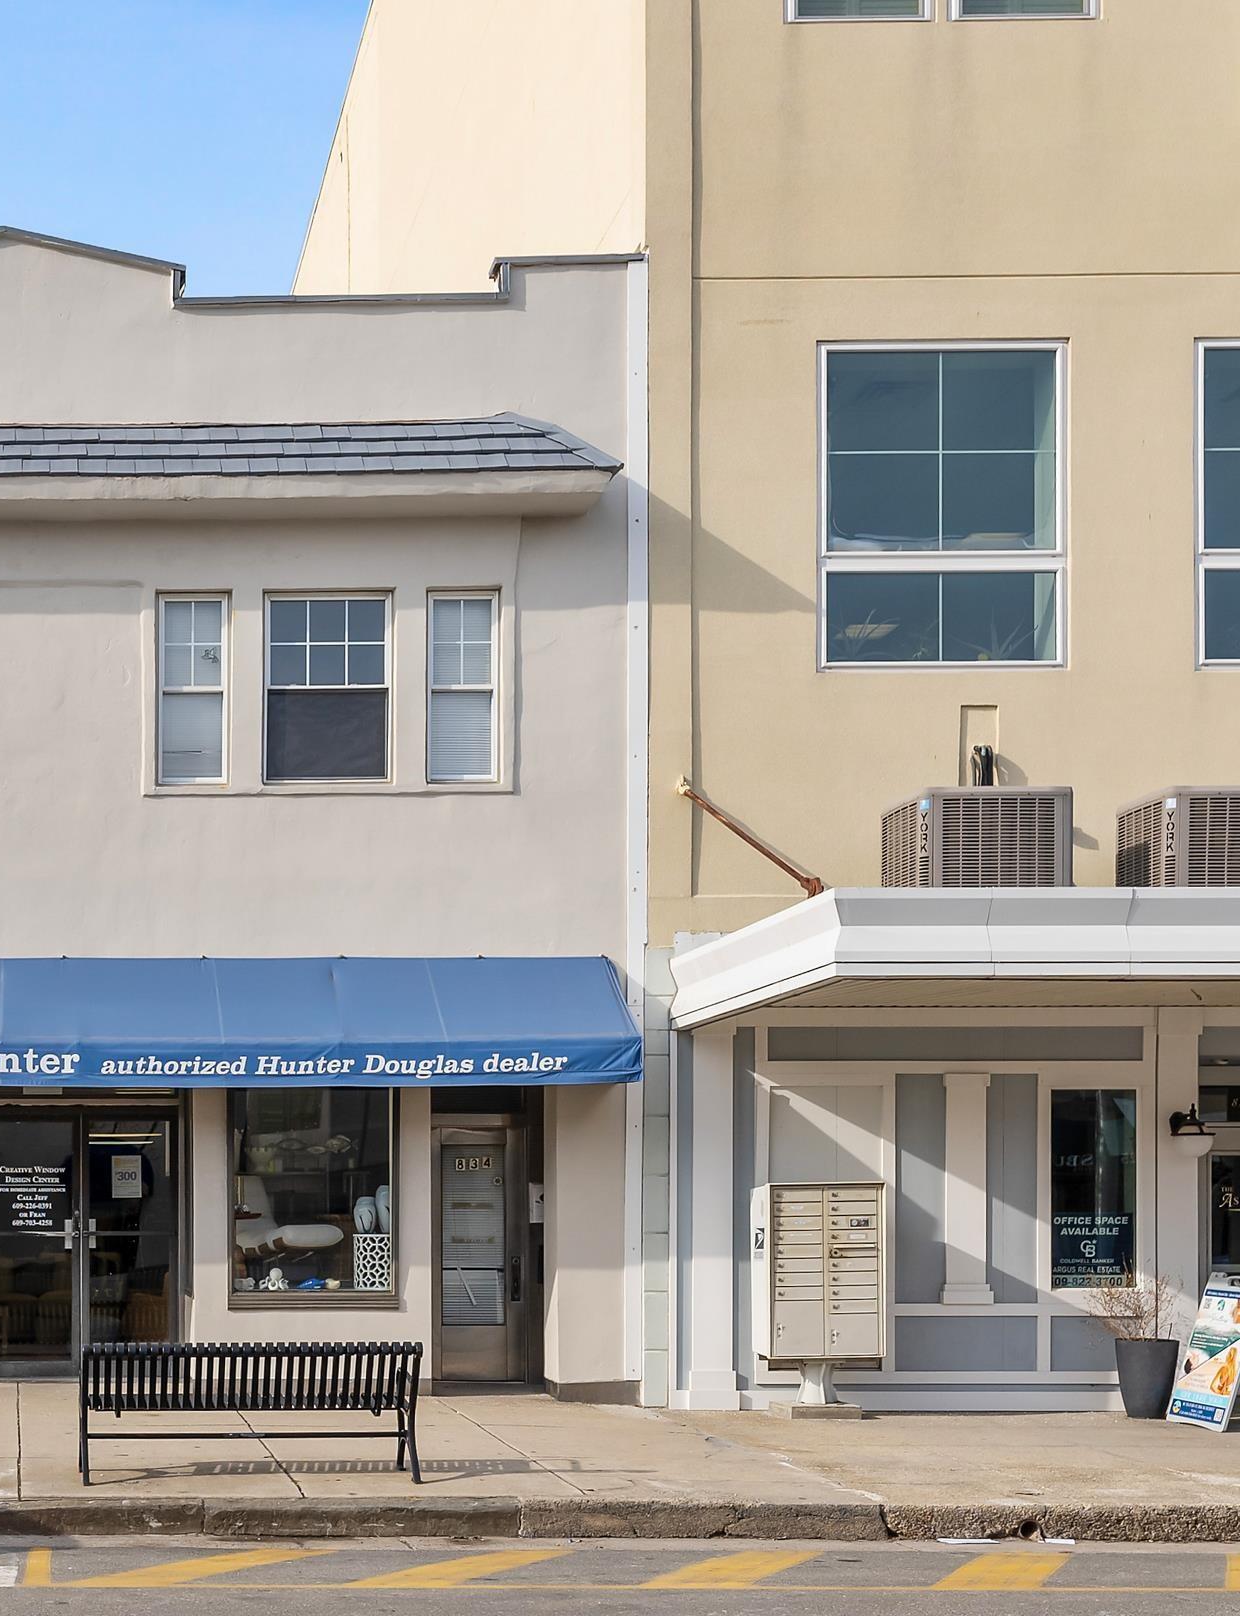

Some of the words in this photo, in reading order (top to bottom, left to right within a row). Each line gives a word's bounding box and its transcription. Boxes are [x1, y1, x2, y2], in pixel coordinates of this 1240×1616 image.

[920, 812, 928, 853] YORK
[1166, 811, 1175, 852] YORK
[100, 1055, 247, 1075] authorized
[254, 1055, 355, 1075] Hunter
[362, 1054, 475, 1079] Douglas
[482, 1052, 568, 1073] dealer
[456, 1158, 491, 1170] 834
[1053, 1216, 1092, 1225] OFFICE
[1094, 1216, 1129, 1225] SPACE
[1060, 1227, 1120, 1236] AVAILABLE
